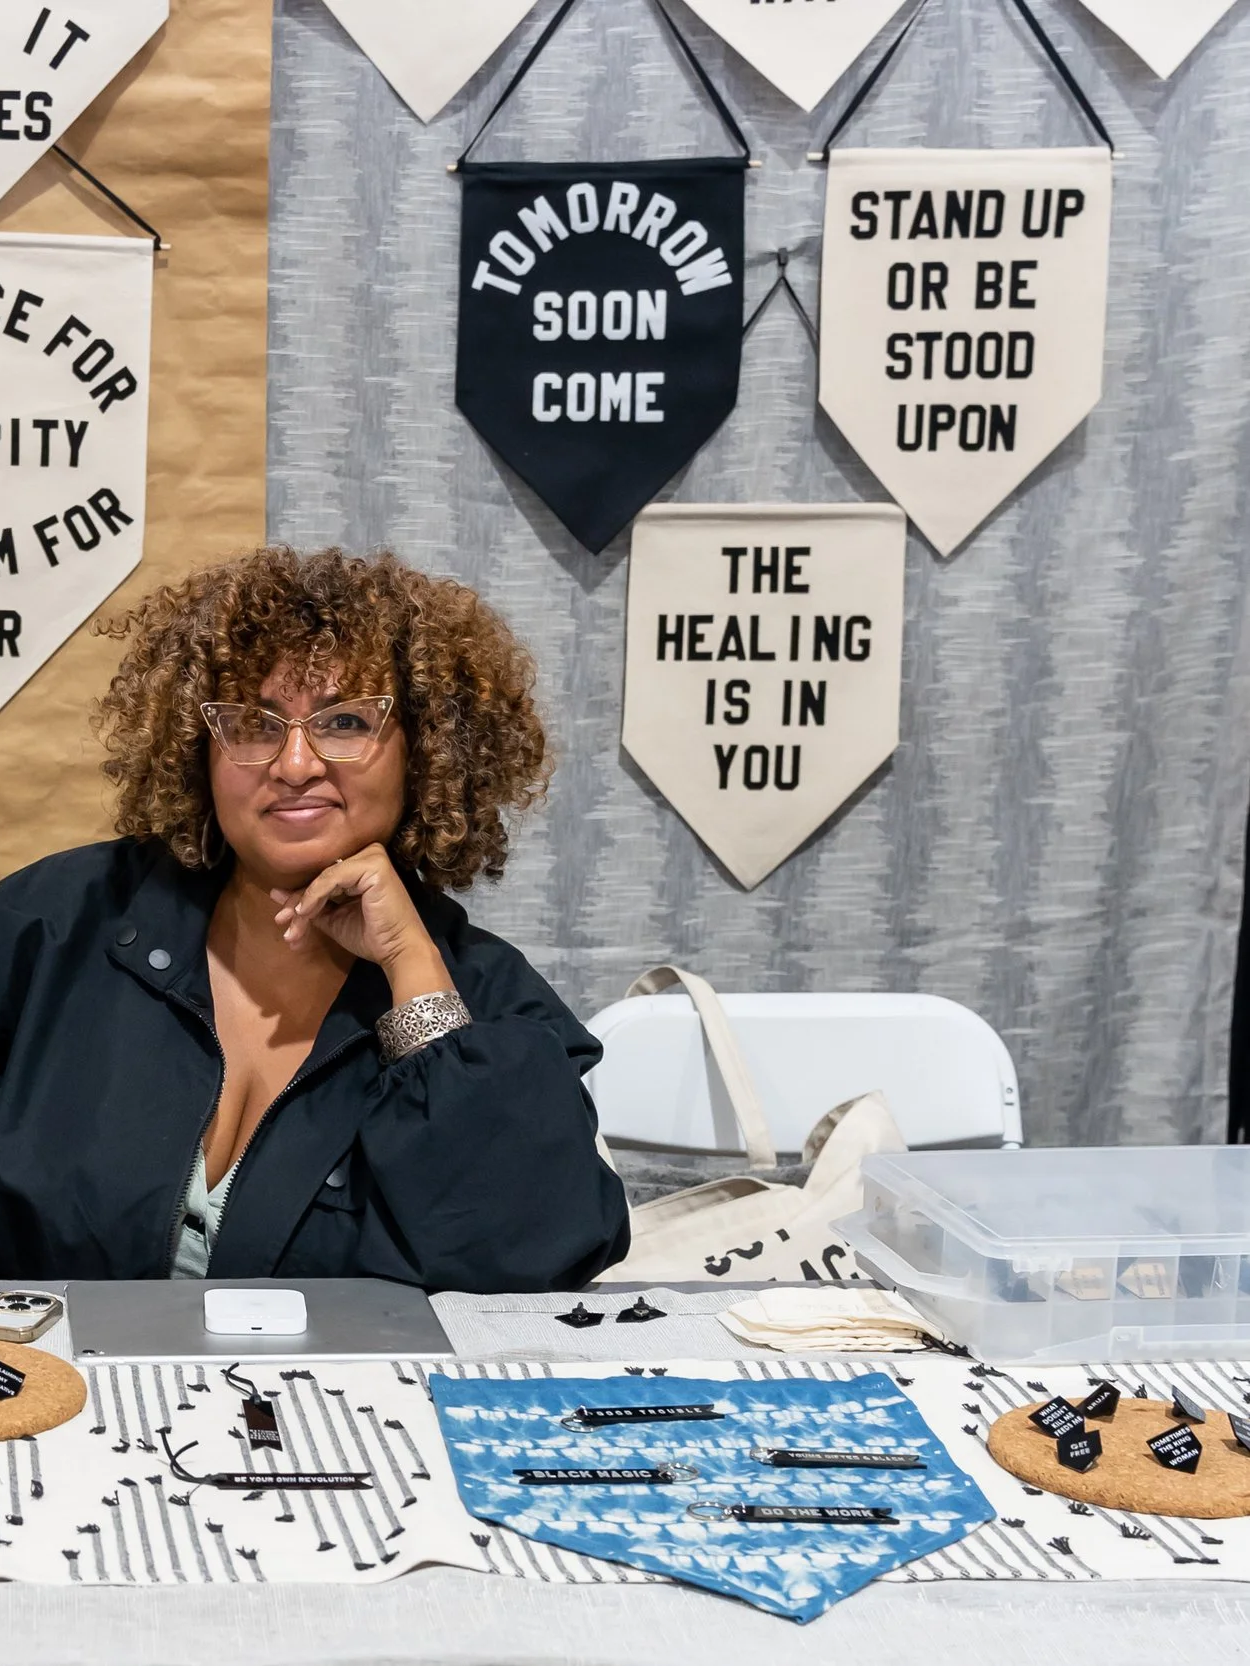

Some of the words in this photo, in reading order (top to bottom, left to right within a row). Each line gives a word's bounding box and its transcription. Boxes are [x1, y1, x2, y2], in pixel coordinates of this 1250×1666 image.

[24, 8, 89, 69] IT
[851, 190, 1005, 239] STAND
[1023, 189, 1084, 238] UP
[472, 182, 732, 296] TOMORROW
[888, 262, 948, 310] OR
[976, 261, 1037, 309] BE
[533, 290, 666, 340] SOON
[43, 315, 137, 413] FOR
[886, 332, 1034, 379] STOOD
[533, 372, 664, 422] COME
[897, 404, 1016, 451] UPON
[33, 488, 133, 567] FOR
[722, 547, 810, 593] THE
[657, 615, 871, 661] HEALING
[706, 680, 750, 725] IS
[782, 680, 826, 726] IN
[714, 745, 800, 790] YOU
[1039, 1402, 1059, 1418] WHAT
[1050, 1419, 1066, 1430] KILL
[1063, 1411, 1075, 1421] ME
[1086, 1391, 1111, 1411] BRUJA
[1053, 1422, 1074, 1437] FEEDS
[1071, 1415, 1084, 1427] ME
[1070, 1440, 1088, 1450] GET
[1150, 1426, 1191, 1450] SOMETIMES
[1158, 1443, 1174, 1454] THE
[1172, 1435, 1192, 1448] KING
[532, 1470, 593, 1479] BLACK
[596, 1470, 652, 1479] MAGIC
[1069, 1448, 1090, 1458] FREE
[1169, 1448, 1199, 1466] WOMAN
[298, 1476, 355, 1484] REVOLUTION
[760, 1508, 784, 1517] DO
[788, 1508, 822, 1517] THE
[825, 1508, 874, 1518] WORK
